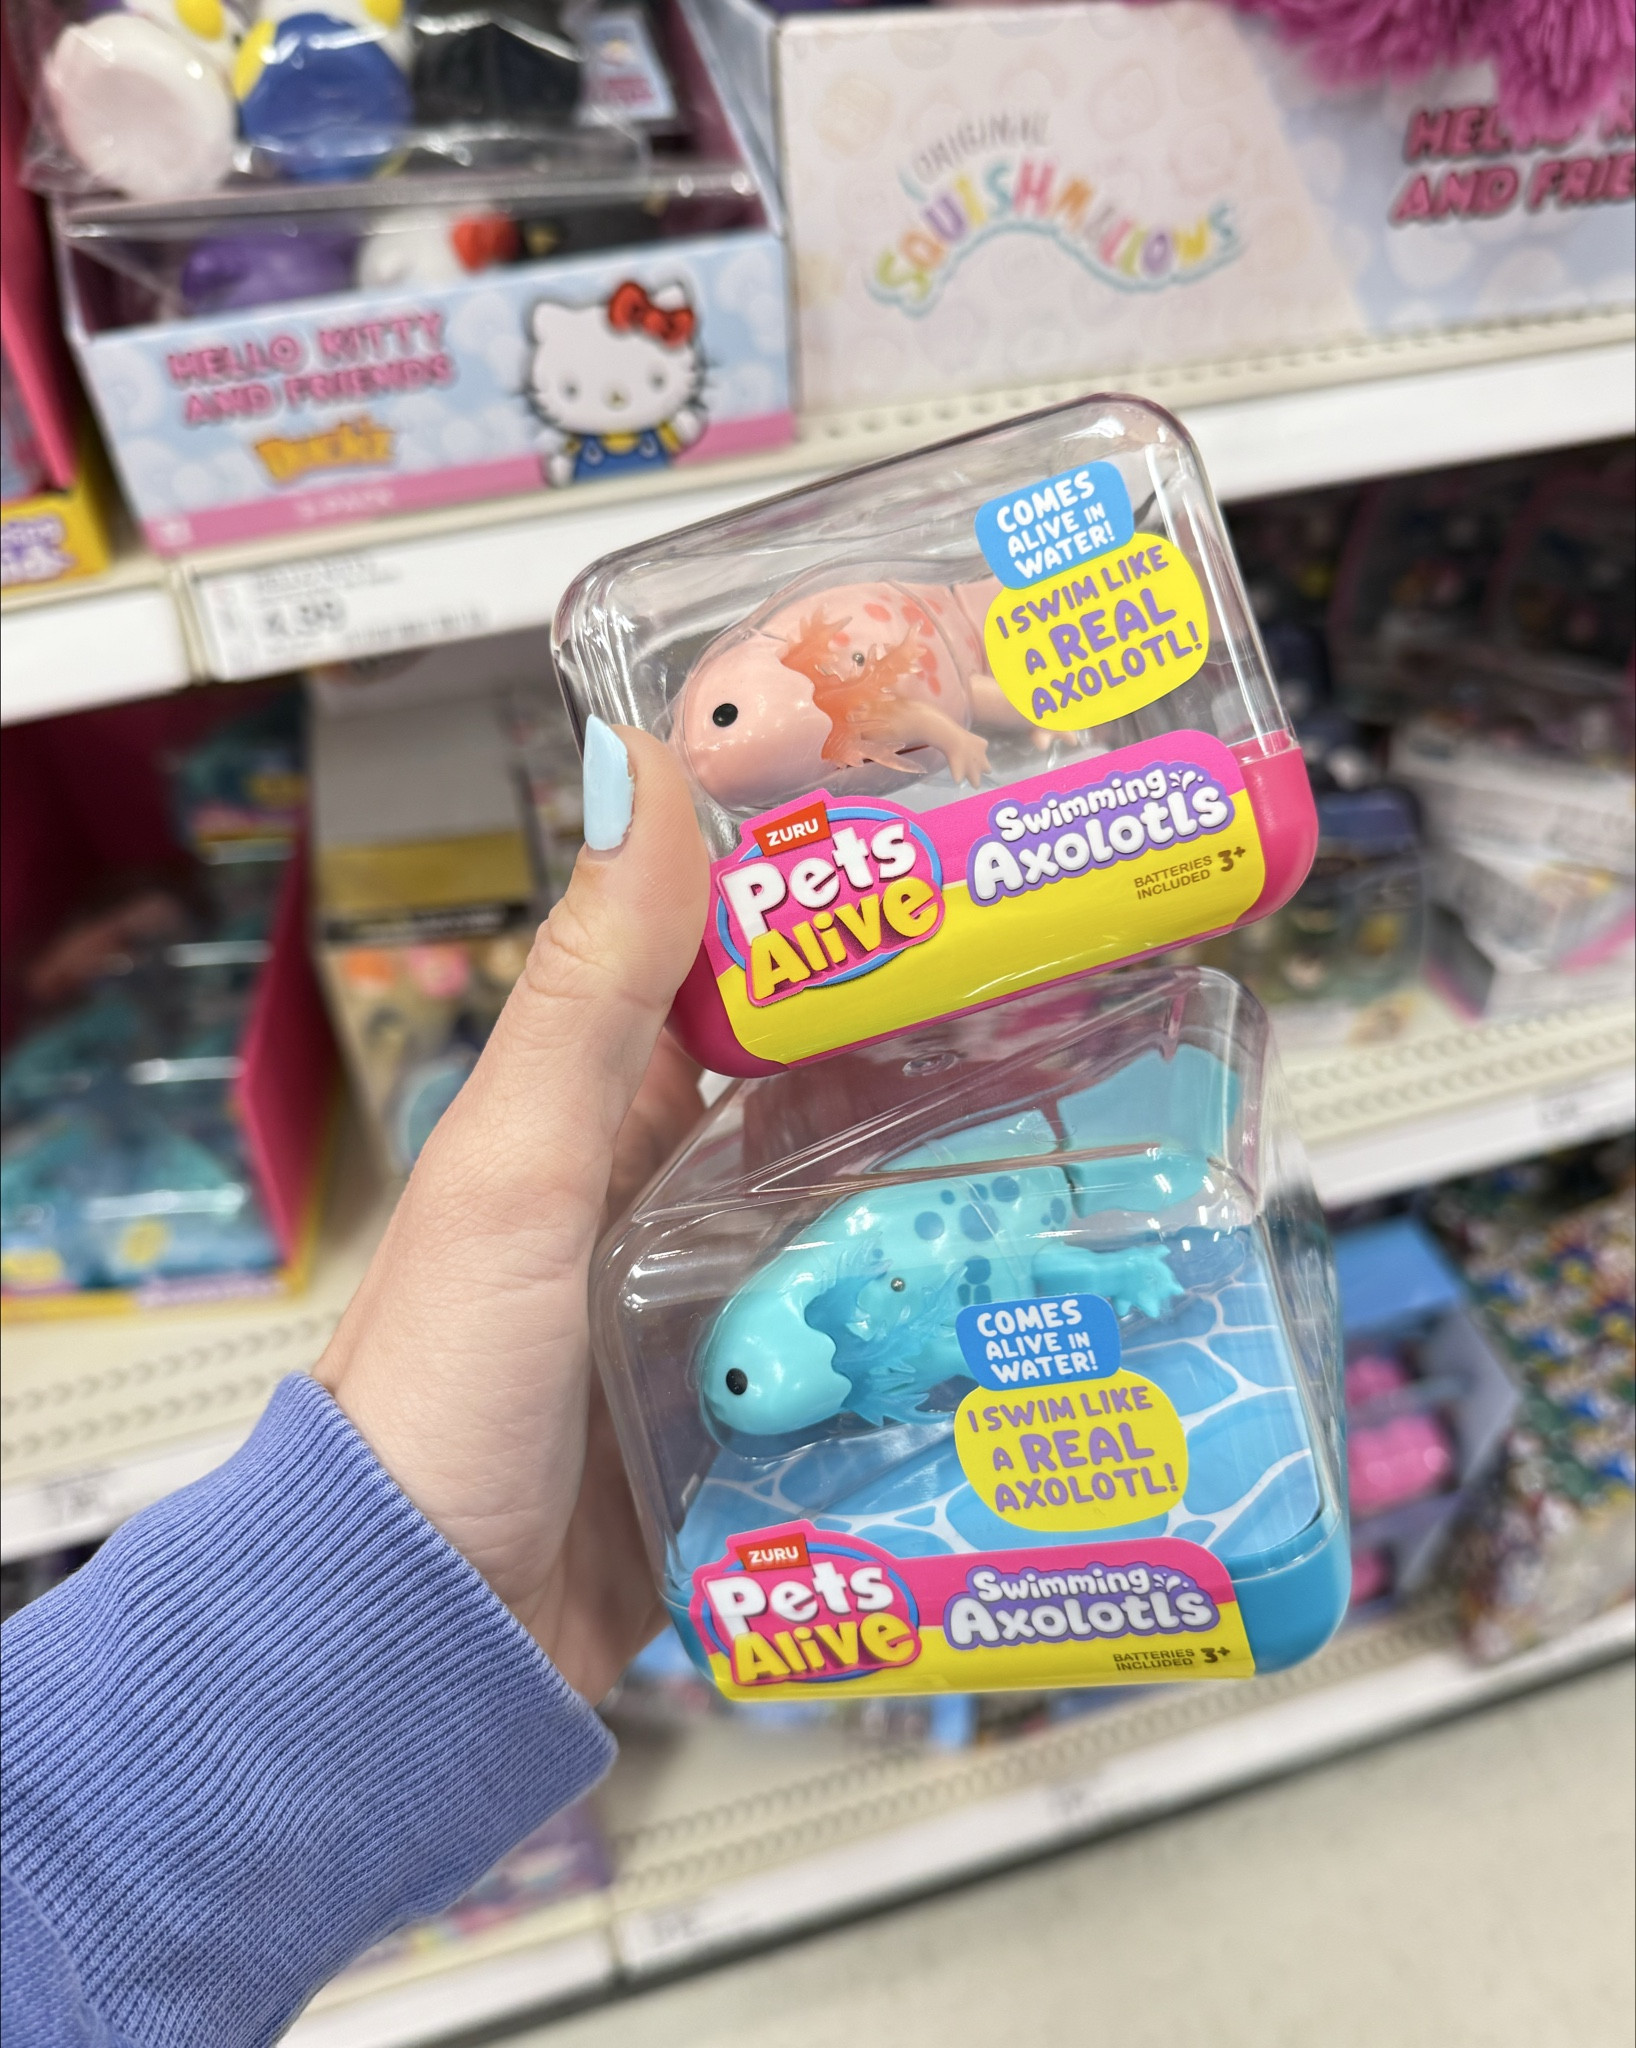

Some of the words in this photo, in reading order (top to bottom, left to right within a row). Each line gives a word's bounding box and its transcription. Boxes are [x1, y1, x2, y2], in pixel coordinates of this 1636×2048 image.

[1390, 165, 1519, 227] AND
[167, 333, 301, 382] HELLO
[318, 312, 442, 366] KITTY
[184, 381, 275, 424] AND
[284, 352, 455, 408] FRIENDS
[996, 470, 1096, 533] COMES
[1006, 509, 1080, 558] ALIVE
[1083, 502, 1107, 522] IN
[1014, 519, 1116, 580] WATER!
[995, 615, 1010, 640] I
[1010, 575, 1100, 634] SWIM
[1100, 544, 1169, 592] LIKE
[1025, 648, 1048, 676] A
[1048, 587, 1178, 668] REAL
[1031, 620, 1203, 720] AXOLOTL!
[766, 818, 819, 847] ZURU
[995, 768, 1168, 842] Swimming
[973, 786, 1229, 900] Axolotls
[1133, 854, 1213, 889] BATTERIES
[1216, 845, 1246, 873] 3+
[721, 823, 918, 947] Pets
[1136, 868, 1211, 900] INCLUDED
[750, 875, 940, 1001] Alive
[976, 1299, 1083, 1338] COMES
[985, 1331, 1062, 1361] ALIVE
[1068, 1331, 1091, 1350] IN
[990, 1350, 1099, 1384] WATER!
[967, 1410, 979, 1433] I
[982, 1396, 1076, 1432] SWIM
[1080, 1386, 1153, 1417] LIKE
[992, 1446, 1014, 1472] A
[1019, 1422, 1155, 1474] REAL
[995, 1462, 1179, 1513] AXOLOTL!
[748, 1546, 799, 1564] ZURU
[706, 1561, 895, 1641] Pets
[972, 1567, 1150, 1602] Swimming
[950, 1591, 1213, 1645] Axolotls
[734, 1612, 916, 1683] Alive
[1113, 1648, 1195, 1663] BATTERIES
[1200, 1646, 1231, 1664] 3+
[1116, 1657, 1193, 1672] INCLUDED
